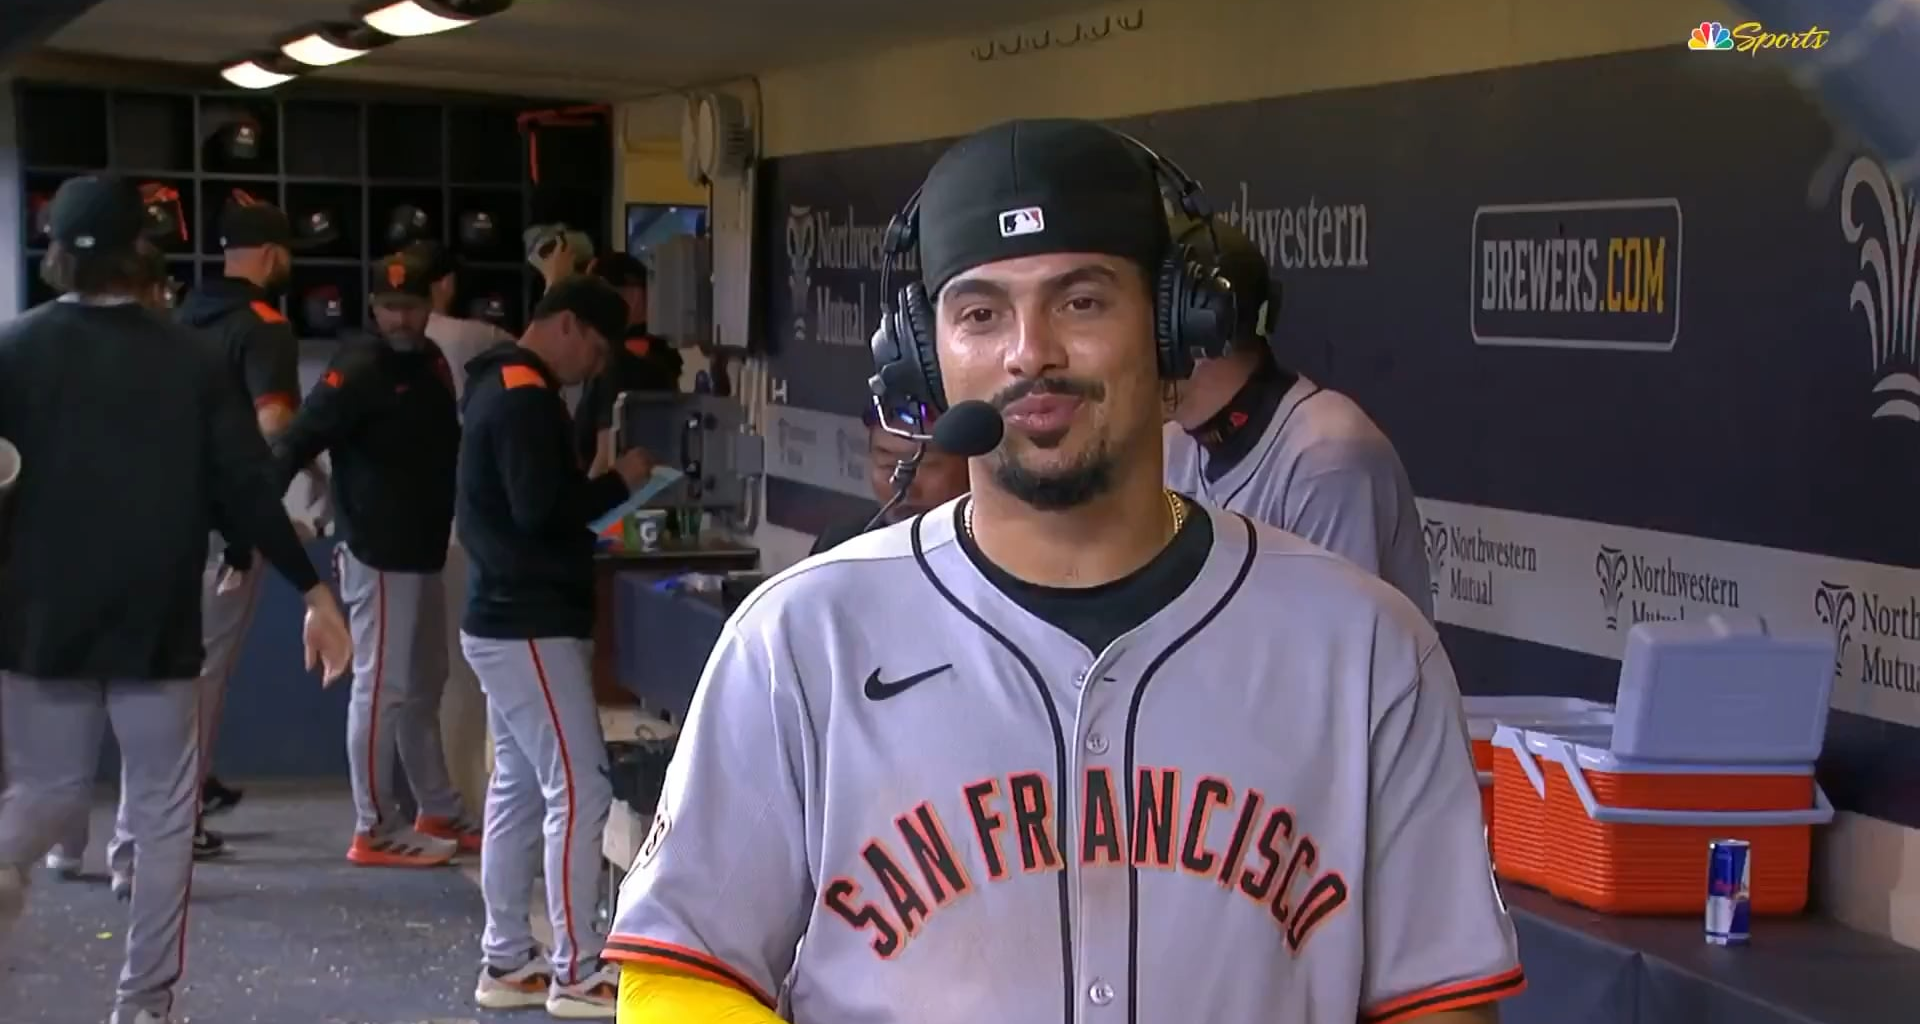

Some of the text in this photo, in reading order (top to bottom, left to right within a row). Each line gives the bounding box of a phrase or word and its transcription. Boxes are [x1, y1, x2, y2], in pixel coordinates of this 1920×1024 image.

[1482, 236, 1666, 313] BREWERS.COM
[816, 281, 865, 345] Mutual
[1450, 526, 1537, 572] Northwestern
[1450, 567, 1493, 605] Mutual
[1632, 555, 1740, 608] Northwestern
[1861, 643, 1920, 694] Mutu
[823, 766, 1348, 960] SAN FRANCISCO
